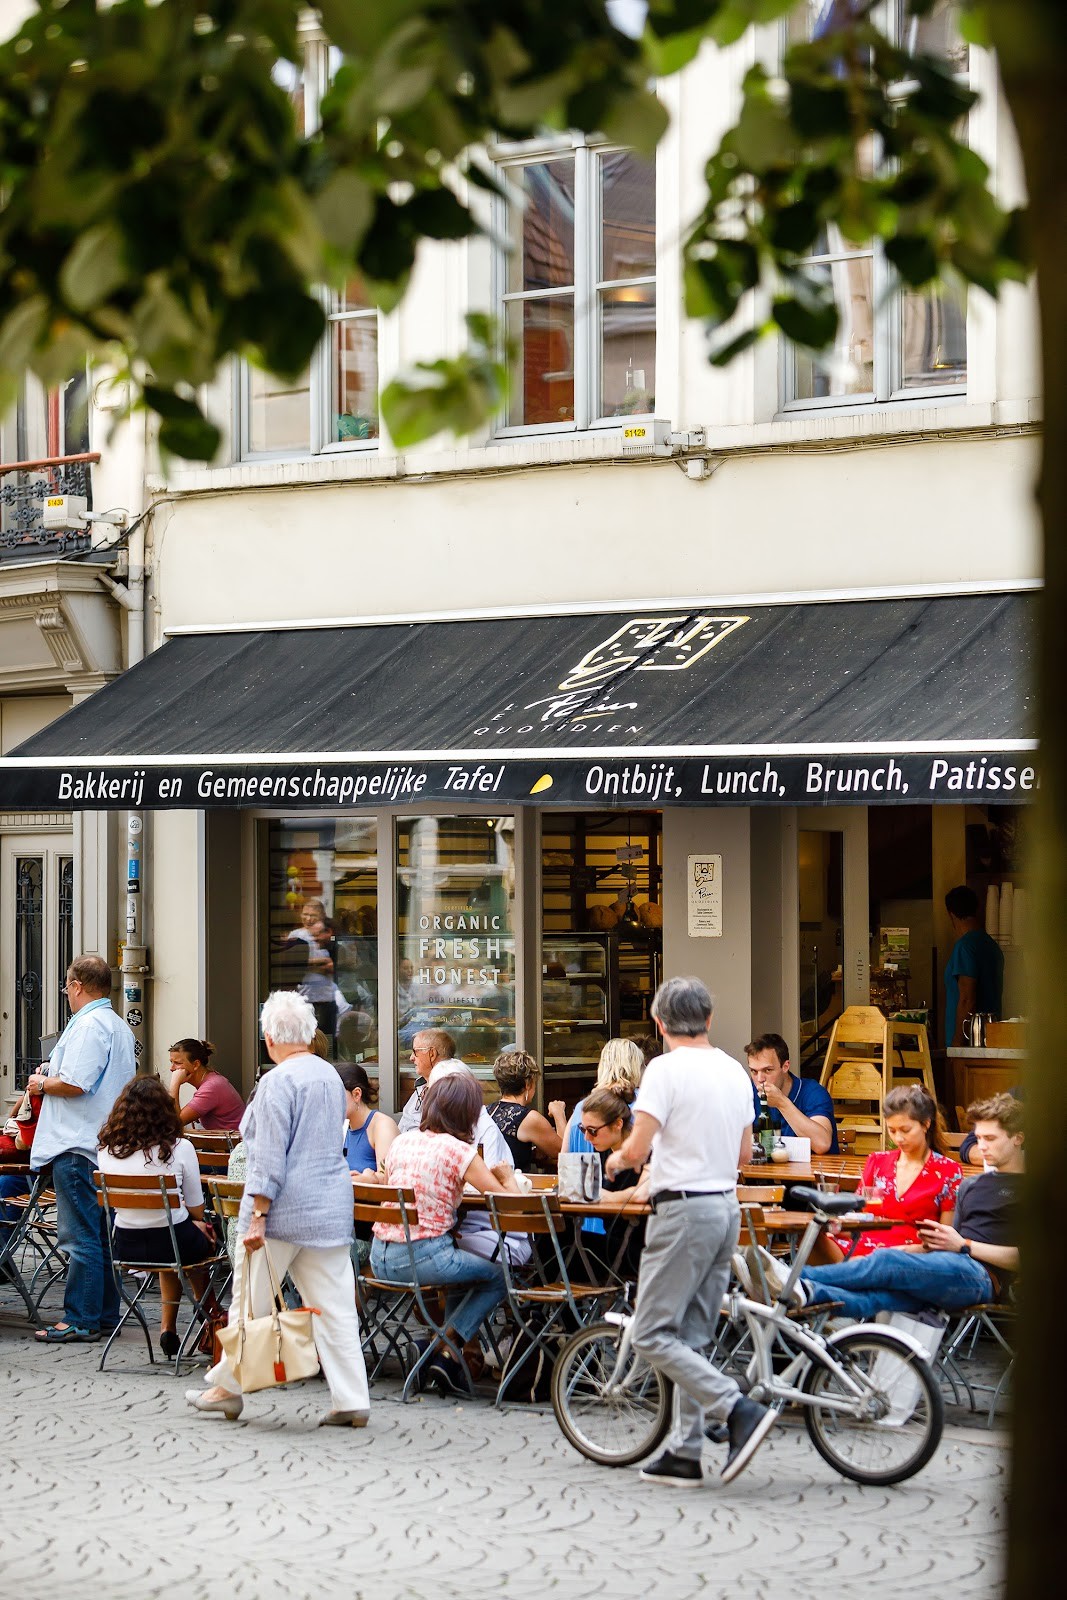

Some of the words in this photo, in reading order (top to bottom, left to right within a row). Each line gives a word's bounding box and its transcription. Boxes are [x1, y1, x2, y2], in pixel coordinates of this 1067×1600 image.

[473, 723, 643, 736] QUOTIDIEN
[58, 770, 146, 806] Bakkerij
[158, 776, 183, 798] en
[197, 766, 428, 804] Gemeenschappelijke
[443, 765, 506, 792] Tafel
[585, 763, 683, 801] Ontbijt,
[700, 761, 786, 797] Lunch,
[805, 758, 910, 794] Brunch,
[419, 915, 501, 930] ORGANIC
[419, 938, 501, 959] FRESH
[419, 968, 501, 985] HONEST
[428, 996, 445, 1004] OUR
